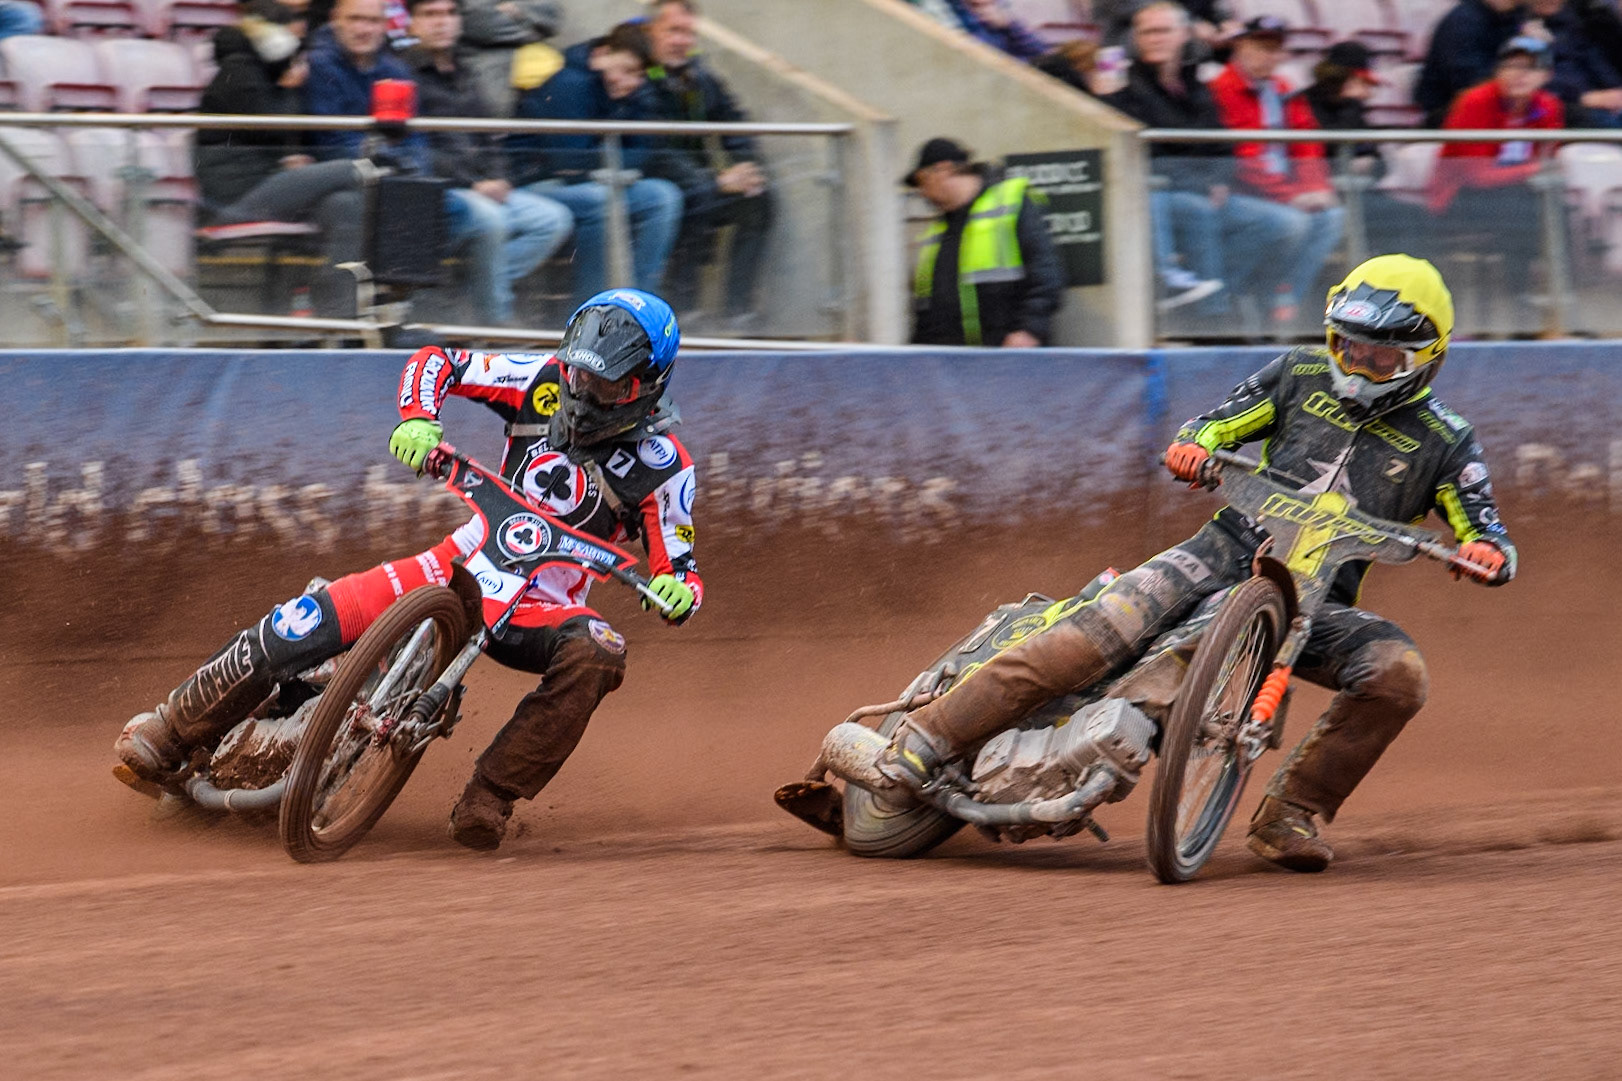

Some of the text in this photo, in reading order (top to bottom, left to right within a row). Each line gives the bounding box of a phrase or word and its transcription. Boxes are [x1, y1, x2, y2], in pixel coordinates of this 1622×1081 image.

[648, 439, 668, 460] ATPI
[612, 450, 632, 470] 7
[1385, 459, 1409, 476] 7
